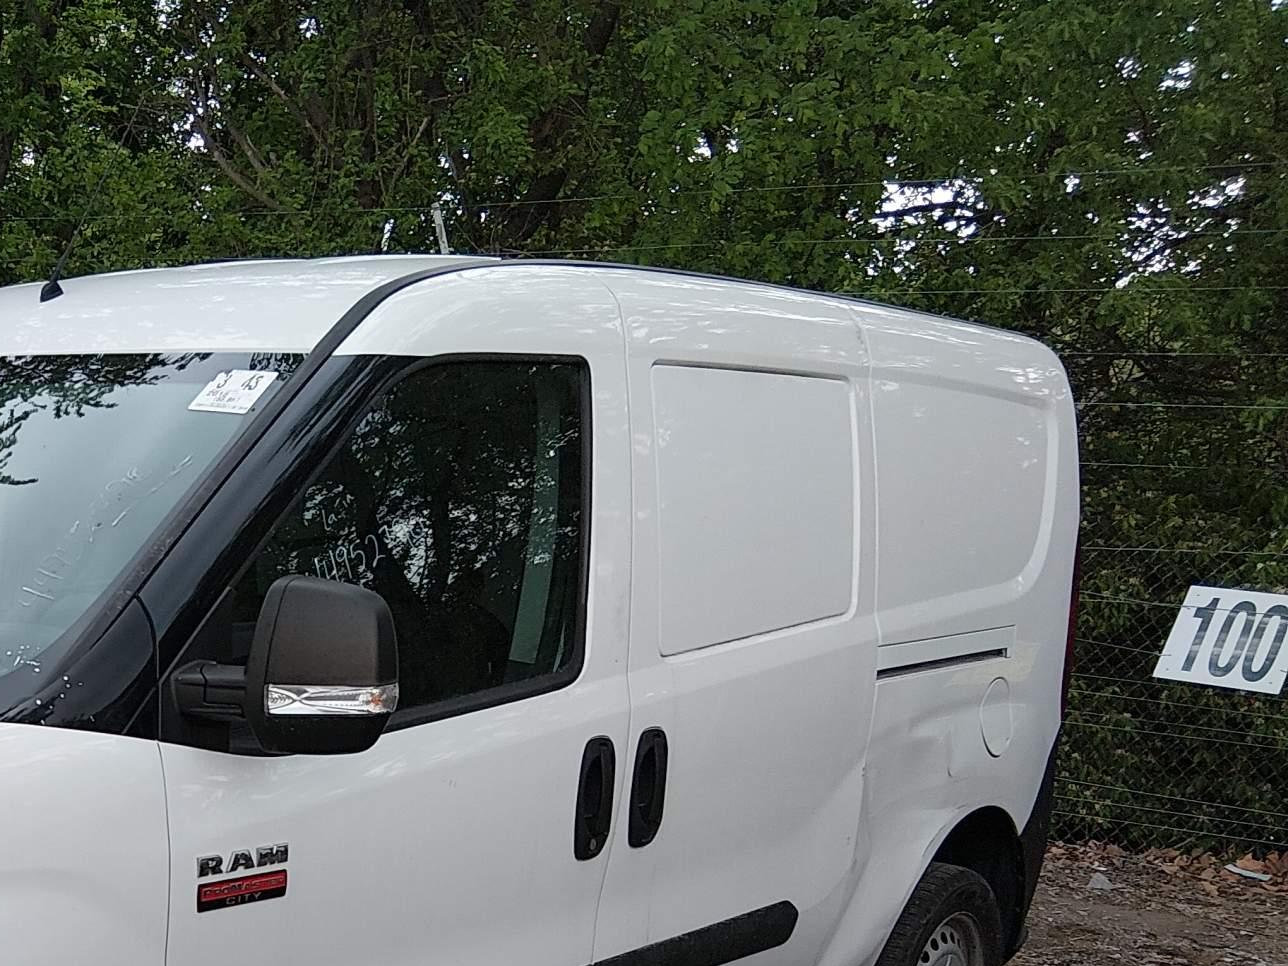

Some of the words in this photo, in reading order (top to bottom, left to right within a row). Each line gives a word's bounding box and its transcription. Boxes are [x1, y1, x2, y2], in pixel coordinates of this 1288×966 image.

[1181, 597, 1288, 682] 100
[197, 842, 289, 878] RAM
[226, 891, 262, 905] CITY
